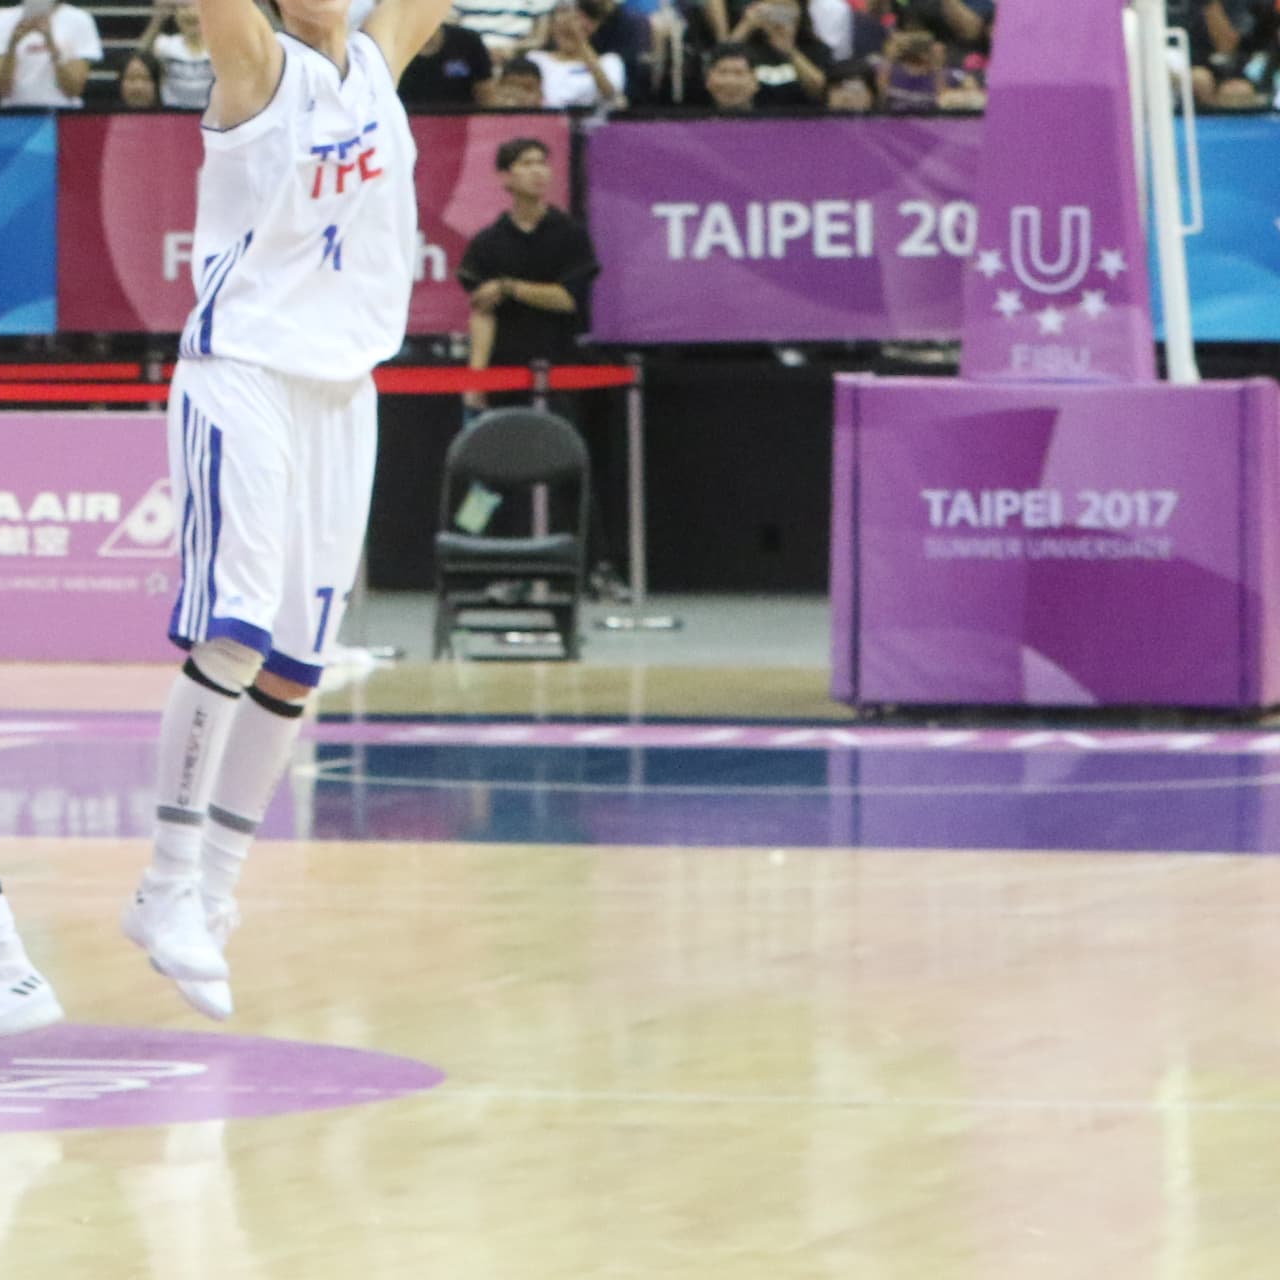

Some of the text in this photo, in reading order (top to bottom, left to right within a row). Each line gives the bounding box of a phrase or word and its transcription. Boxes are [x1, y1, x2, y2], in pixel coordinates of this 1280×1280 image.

[652, 199, 978, 260] TAIPEI 20
[920, 489, 1178, 528] TAIPEI 2017
